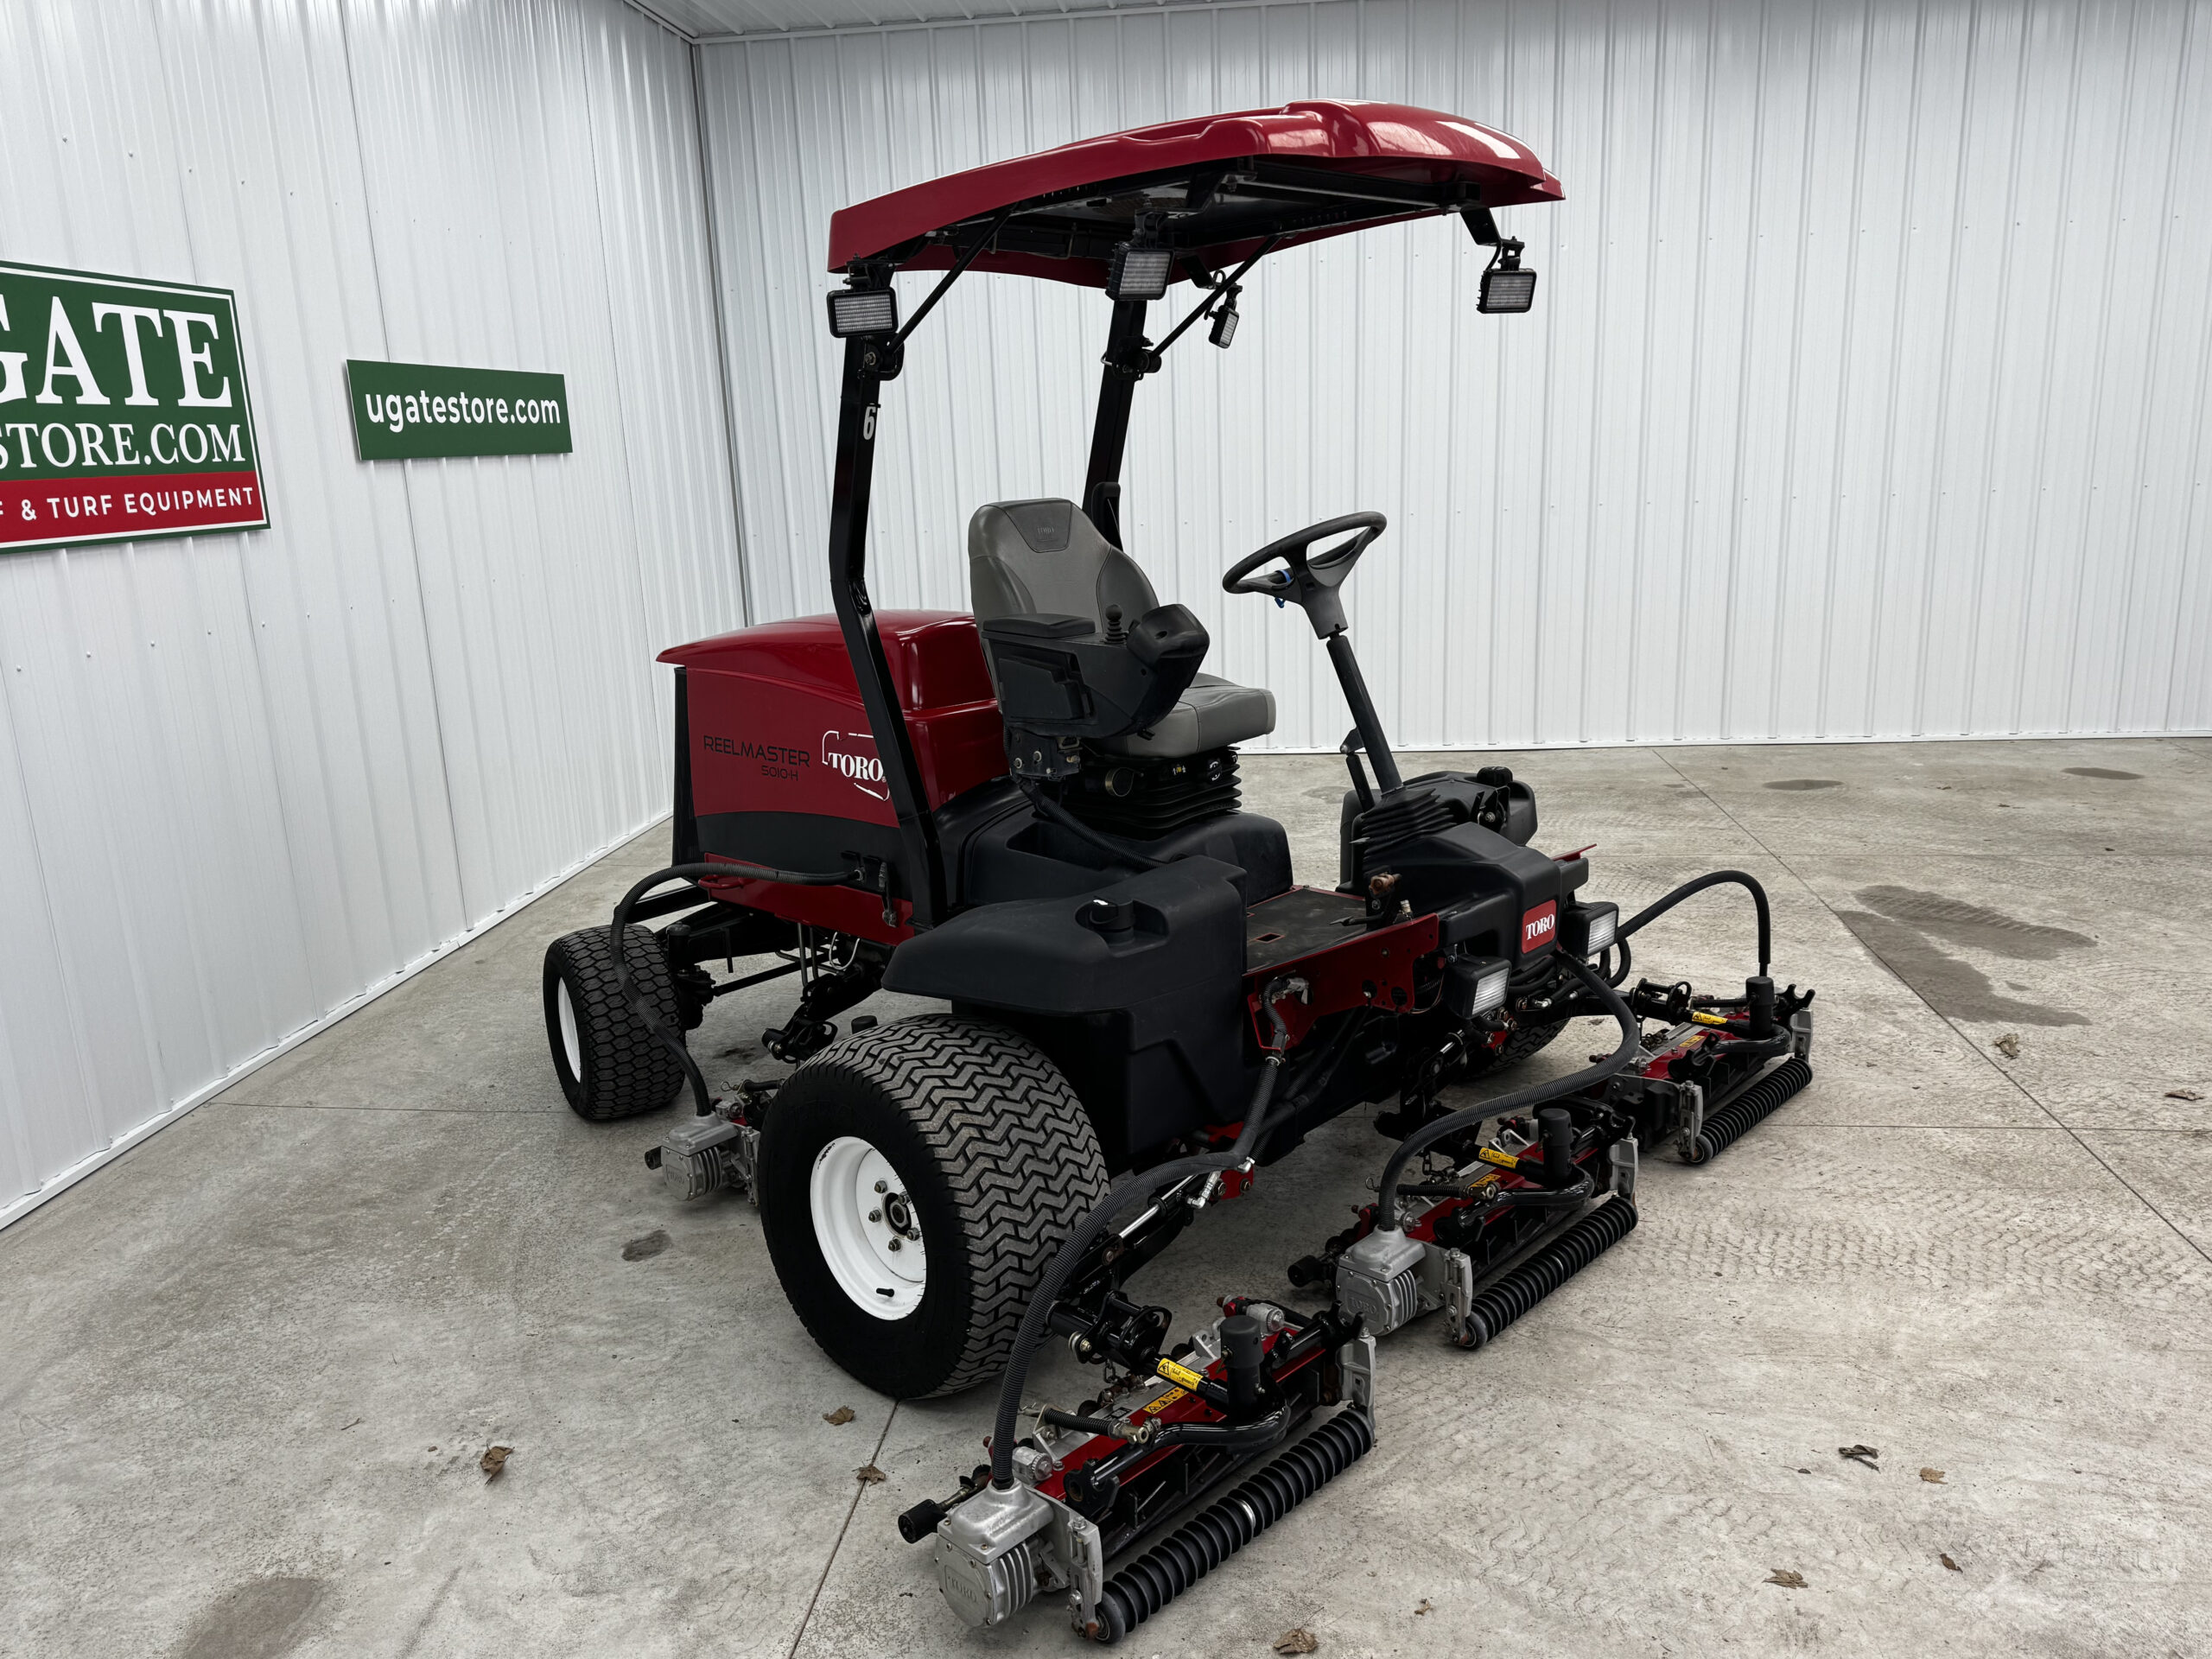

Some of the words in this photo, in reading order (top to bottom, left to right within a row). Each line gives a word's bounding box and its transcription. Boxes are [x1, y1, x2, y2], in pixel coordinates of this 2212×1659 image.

[365, 390, 561, 433] ugatestore.com
[863, 406, 876, 440] 6
[21, 499, 37, 521] &
[47, 494, 112, 519] TURF
[124, 486, 253, 516] EQUIPMENT
[703, 735, 810, 767] REELMASTER
[828, 753, 883, 782] TORO
[1526, 913, 1555, 940] TORO
